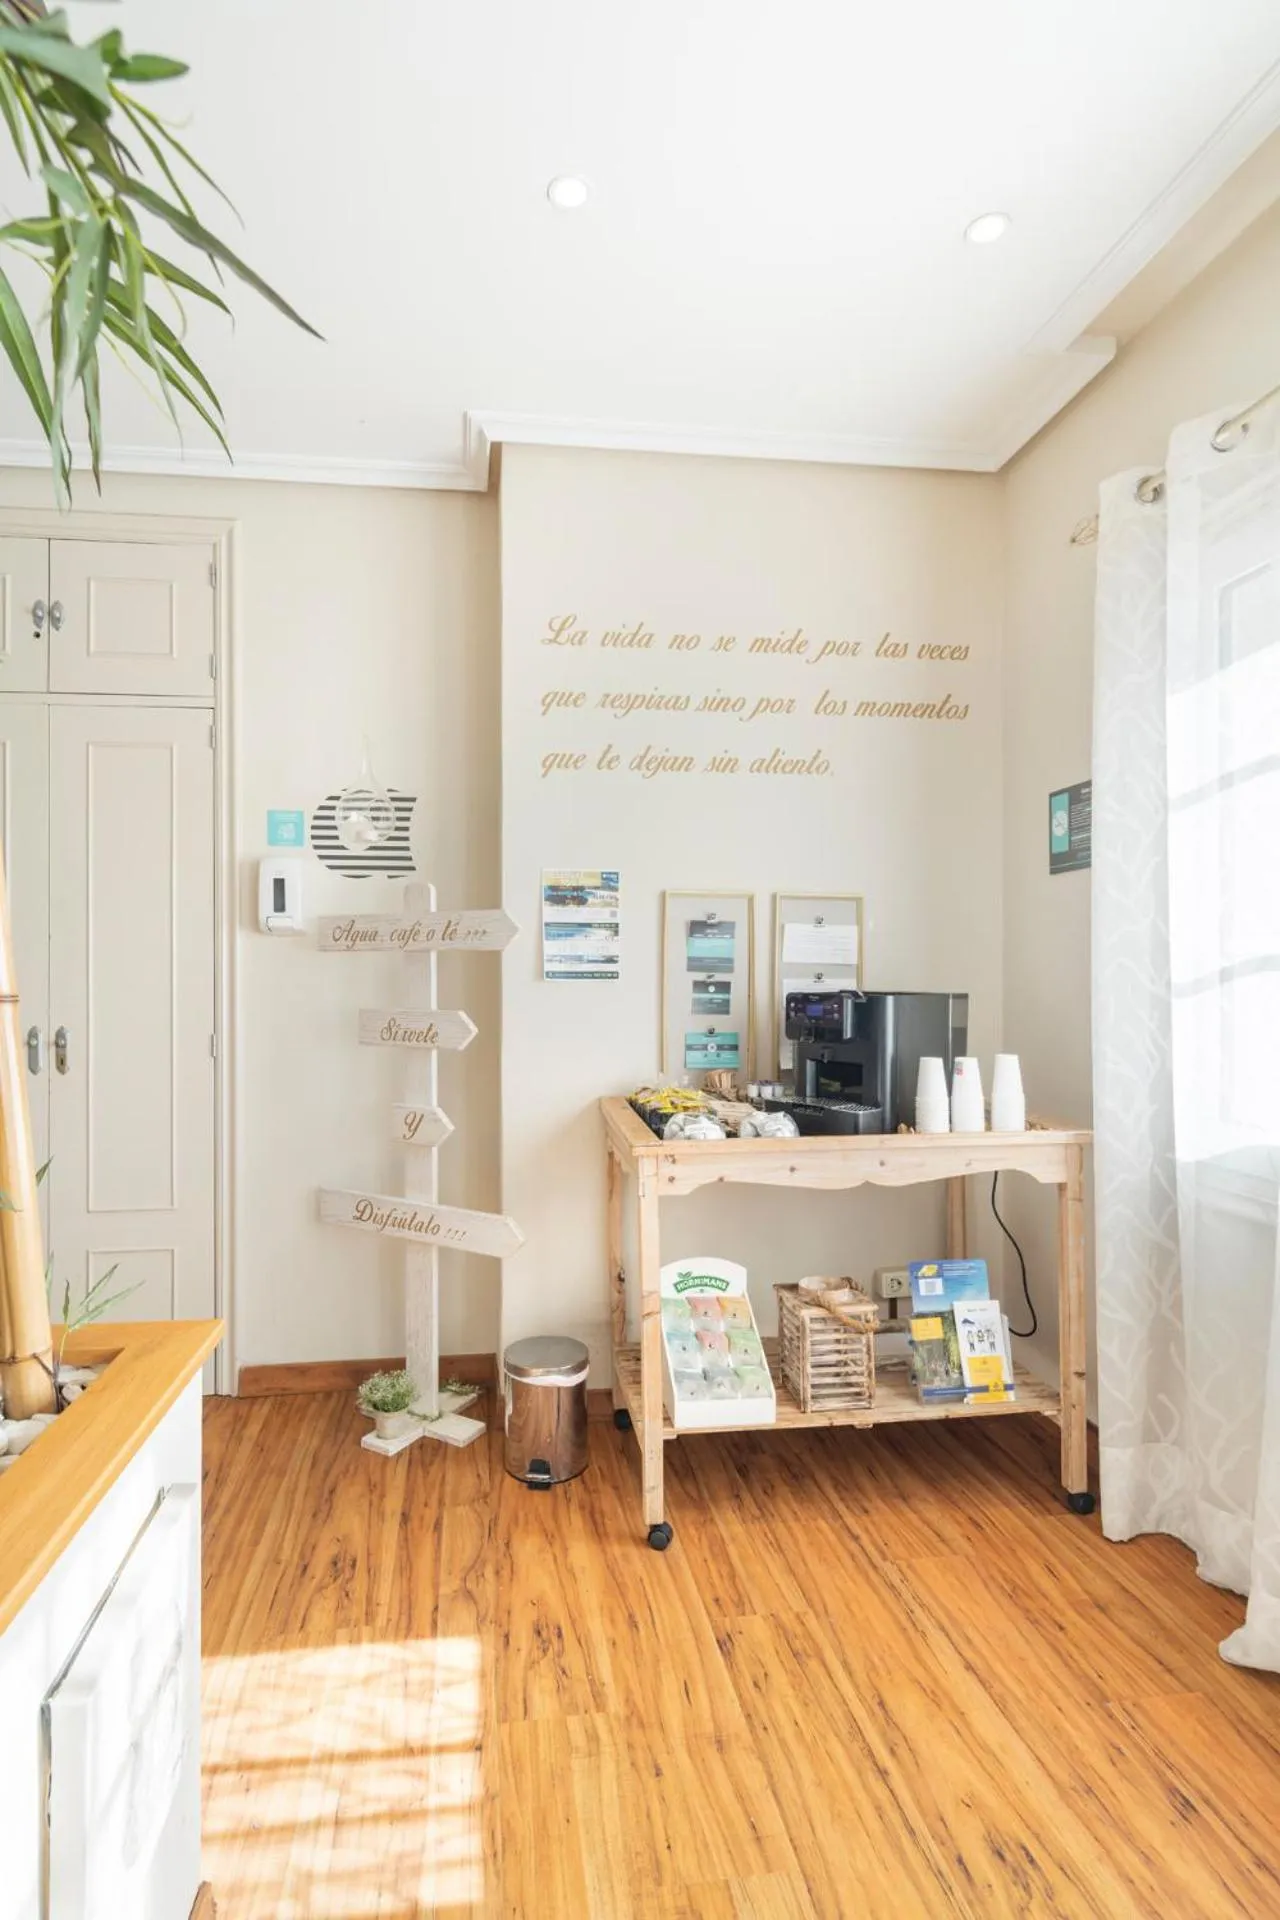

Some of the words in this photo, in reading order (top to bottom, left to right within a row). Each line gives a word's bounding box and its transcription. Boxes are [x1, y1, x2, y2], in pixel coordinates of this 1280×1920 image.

[541, 613, 588, 646] La
[600, 621, 655, 649] vida
[667, 633, 702, 651] no
[709, 636, 737, 652] se
[747, 628, 808, 654] mide
[805, 638, 861, 664] por
[875, 632, 909, 659] las
[916, 642, 970, 661] veces
[541, 691, 586, 716] que
[595, 686, 691, 719] respiras
[694, 688, 746, 713] sino
[738, 695, 796, 722] por
[814, 689, 847, 716] los
[854, 693, 970, 720] momentos
[541, 751, 587, 778] que
[596, 744, 621, 771] te
[628, 745, 696, 779] dejan
[702, 750, 740, 774] sin
[389, 920, 423, 949] café
[426, 928, 436, 942] o
[675, 1276, 728, 1292] HORNIMANS
